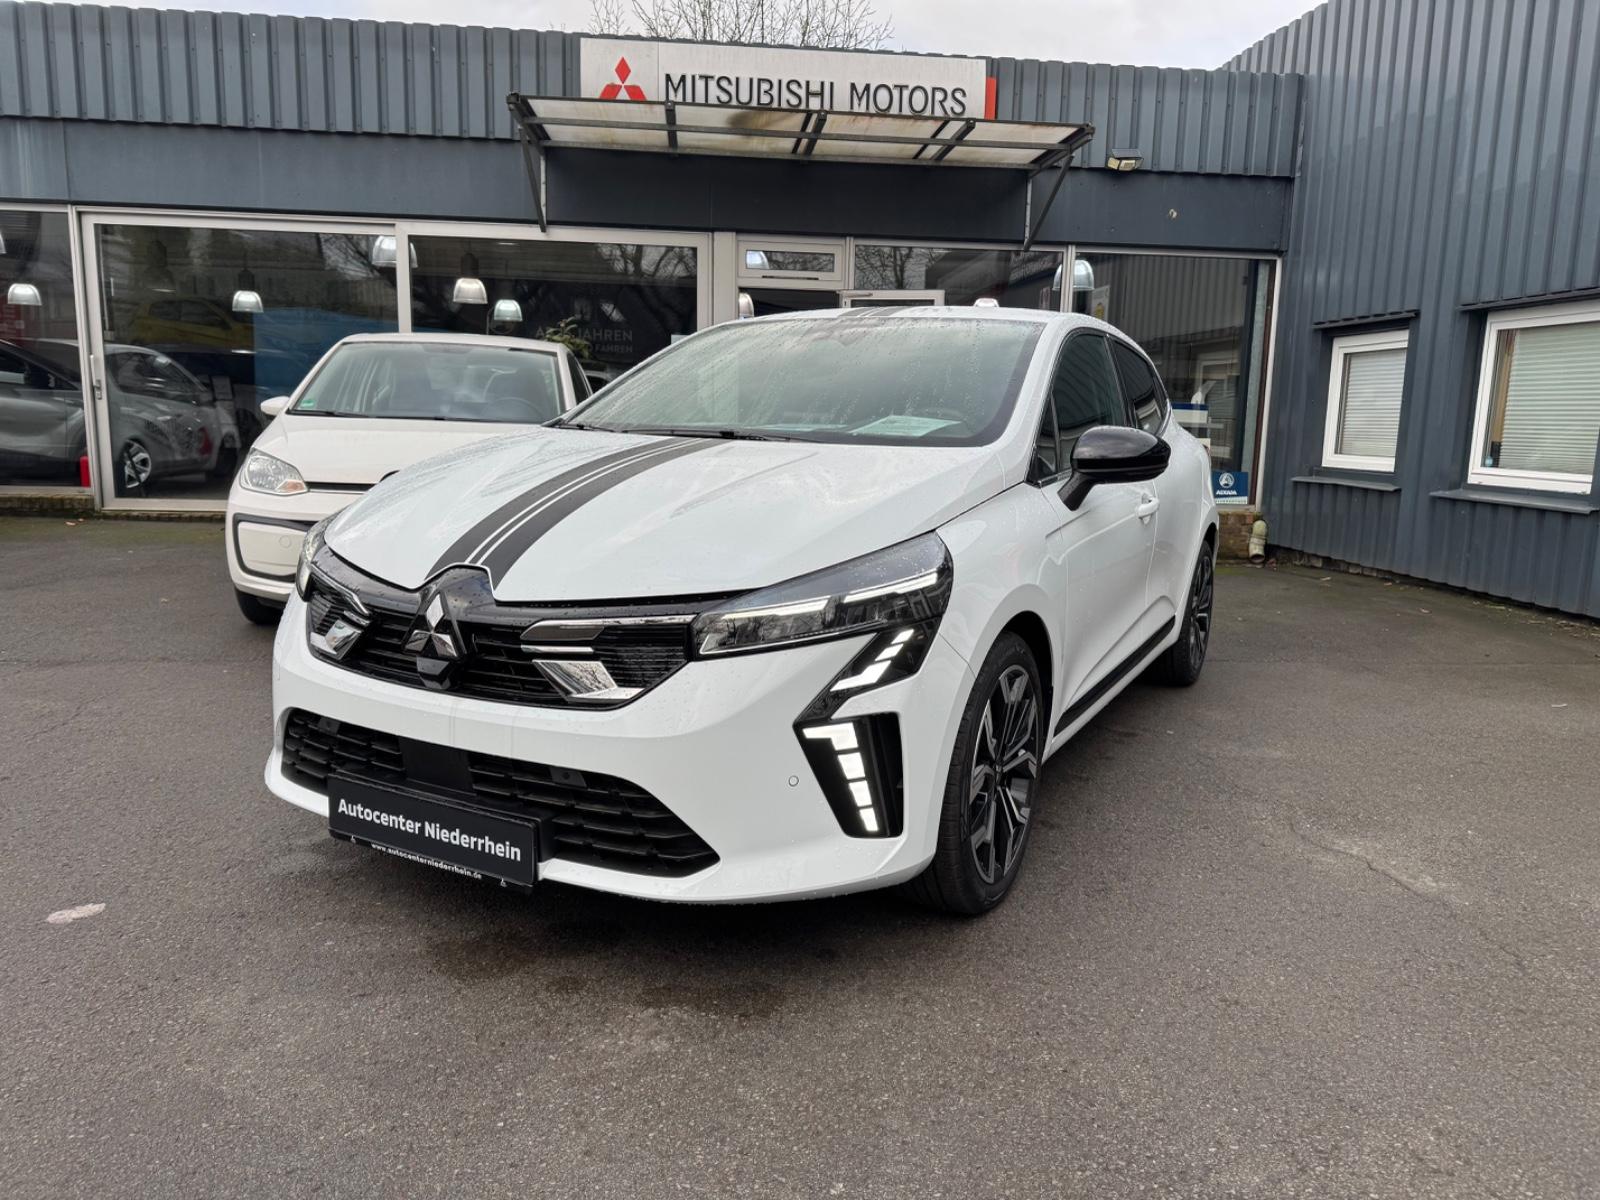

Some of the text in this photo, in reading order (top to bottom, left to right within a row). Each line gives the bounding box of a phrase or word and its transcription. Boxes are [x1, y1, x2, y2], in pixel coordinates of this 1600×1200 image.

[665, 73, 967, 116] MITSUBISHI MOTORS
[338, 798, 521, 862] Autocenter Niederrhein
[371, 842, 483, 880] www.autocenterniederrhein.de
